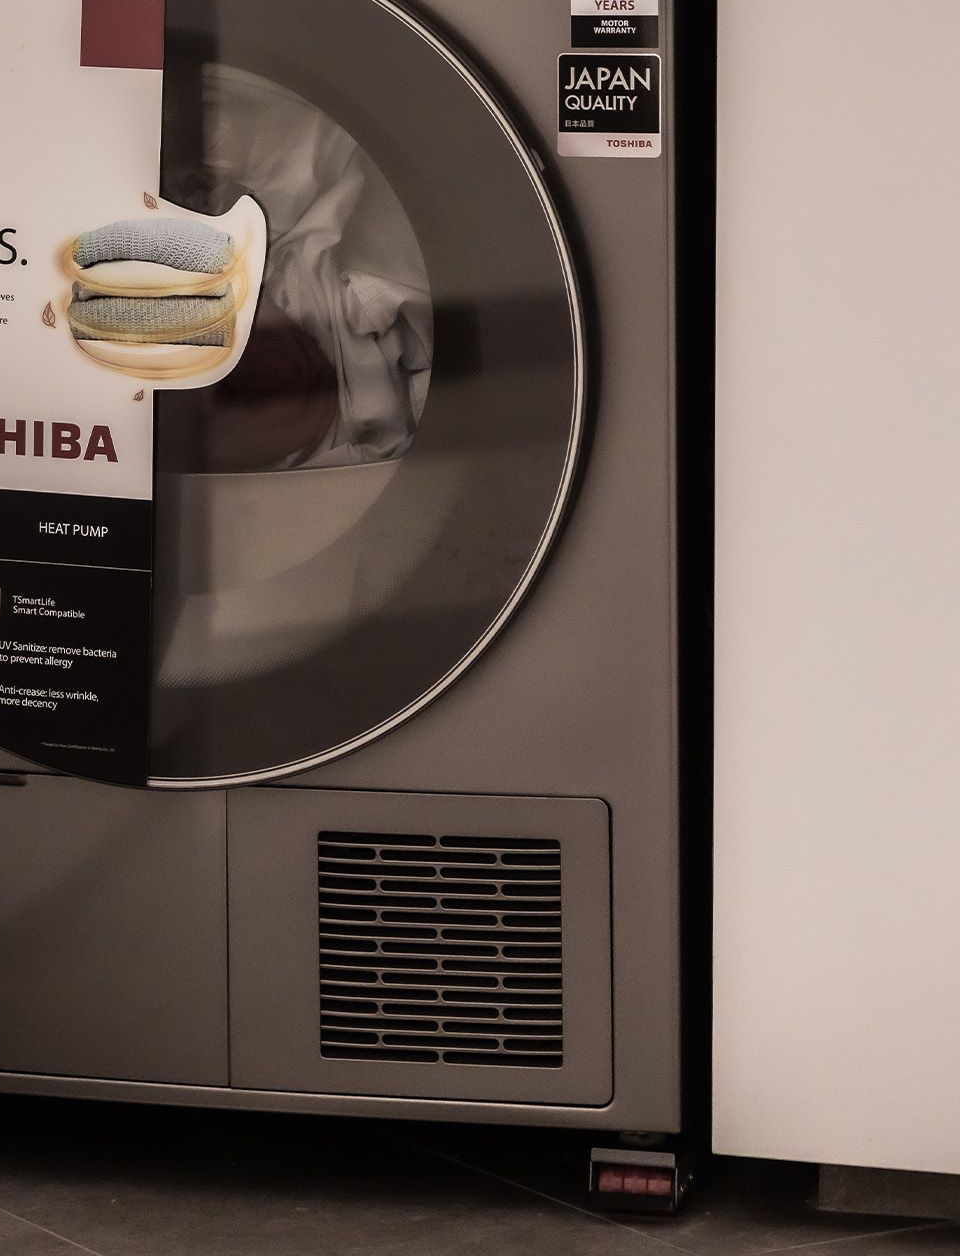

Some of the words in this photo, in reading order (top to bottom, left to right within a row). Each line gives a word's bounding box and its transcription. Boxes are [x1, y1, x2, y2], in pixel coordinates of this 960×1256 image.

[595, 0, 635, 11] YEARS
[564, 66, 651, 91] JAPAN
[565, 95, 637, 111] QUALITY
[606, 139, 653, 148] TOSHIBA
[39, 521, 70, 536] HEAT
[73, 524, 109, 539] PUMP
[12, 595, 56, 607] TSmartLife
[13, 606, 37, 615] Smart
[38, 607, 86, 619] Compatible
[12, 642, 47, 653] Sanitize:
[48, 647, 81, 656] remove
[83, 646, 117, 659] bacteria
[0, 654, 9, 662] to
[10, 654, 43, 665] prevent
[44, 656, 73, 669] allergy
[48, 688, 65, 698] less
[66, 690, 99, 703] wrinkle,
[22, 697, 58, 711] decency
